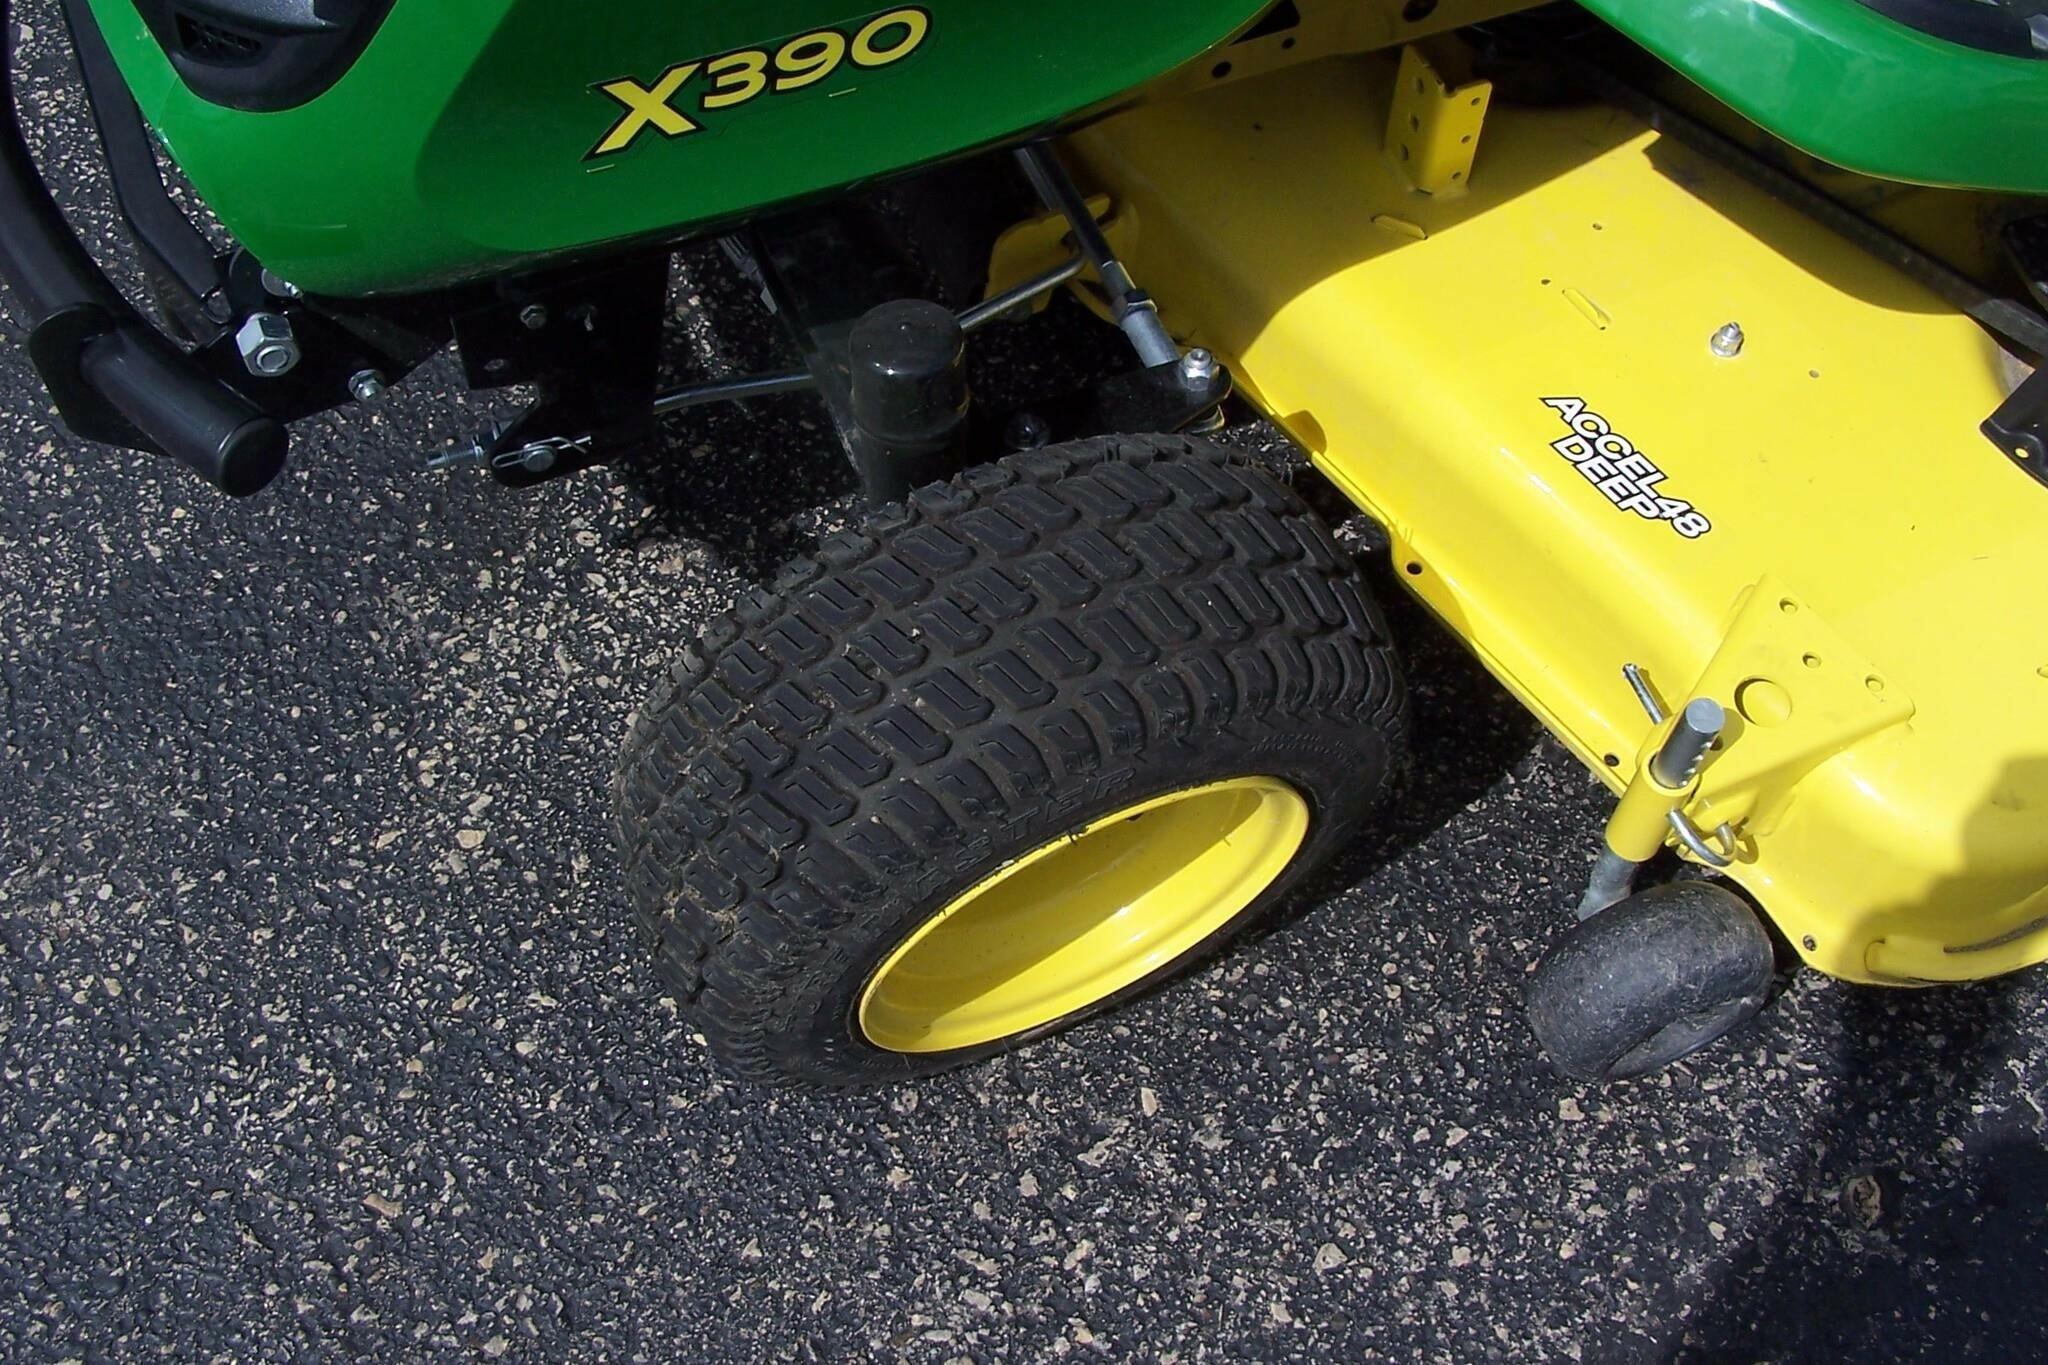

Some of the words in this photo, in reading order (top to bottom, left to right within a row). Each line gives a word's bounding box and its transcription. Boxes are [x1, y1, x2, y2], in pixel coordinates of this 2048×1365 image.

[581, 6, 932, 160] X390
[1541, 397, 1667, 499] ACCEL
[1653, 496, 1711, 538] 48
[1550, 434, 1661, 519] DEEP
